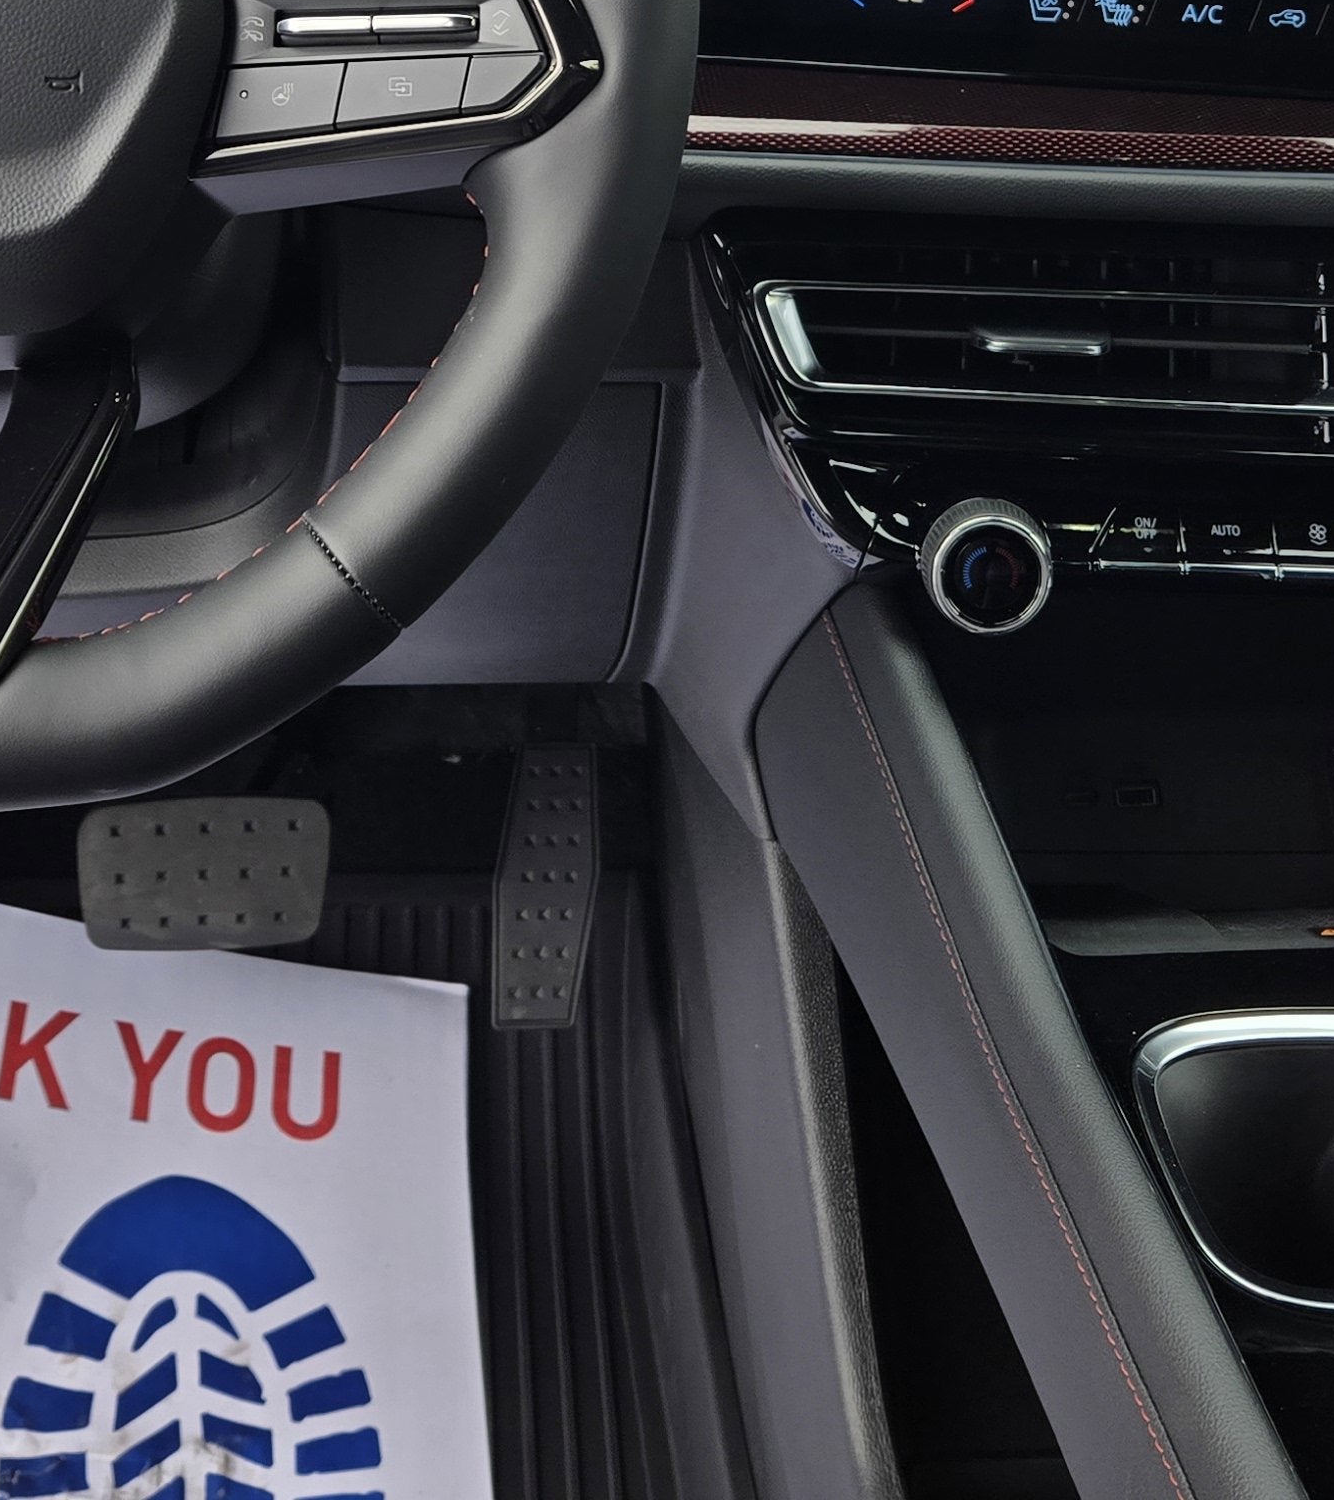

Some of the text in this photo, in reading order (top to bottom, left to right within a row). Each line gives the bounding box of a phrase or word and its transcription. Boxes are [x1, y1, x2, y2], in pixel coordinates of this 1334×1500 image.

[1181, 3, 1224, 25] A/C
[1134, 516, 1157, 529] ON/
[1134, 528, 1157, 540] OFF
[1210, 524, 1241, 537] AUTO
[114, 1019, 342, 1143] YOU
